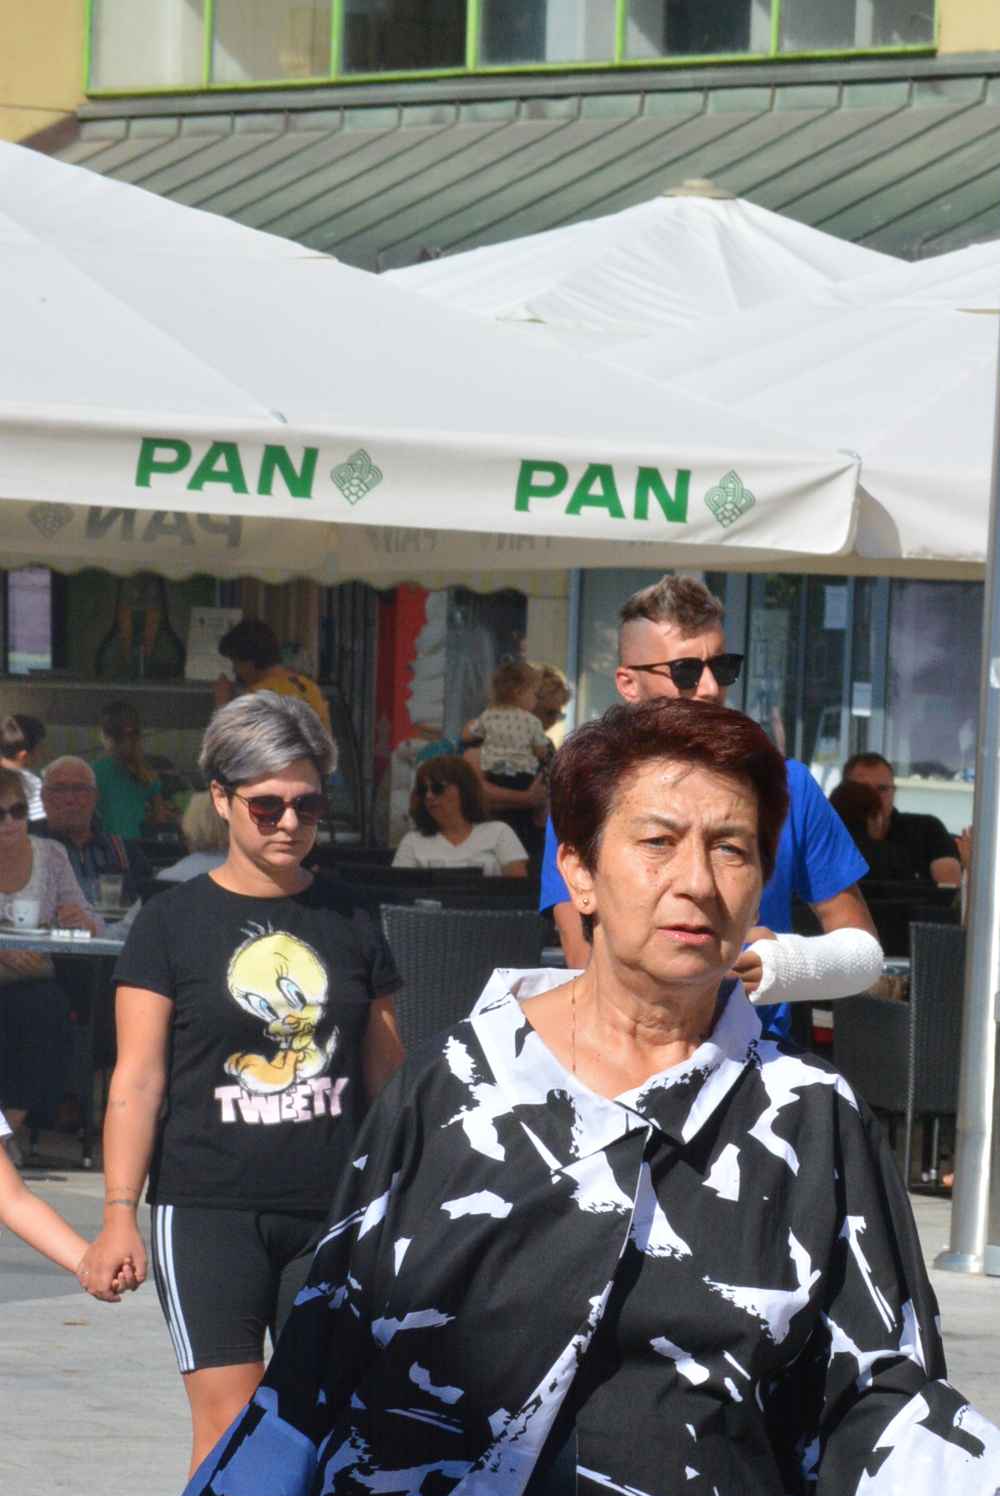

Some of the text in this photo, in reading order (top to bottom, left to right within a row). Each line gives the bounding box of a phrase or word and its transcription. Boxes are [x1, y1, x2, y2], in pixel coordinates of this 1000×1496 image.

[135, 436, 319, 500] PAN
[514, 459, 692, 524] PAN
[214, 1077, 349, 1125] TWEETY
